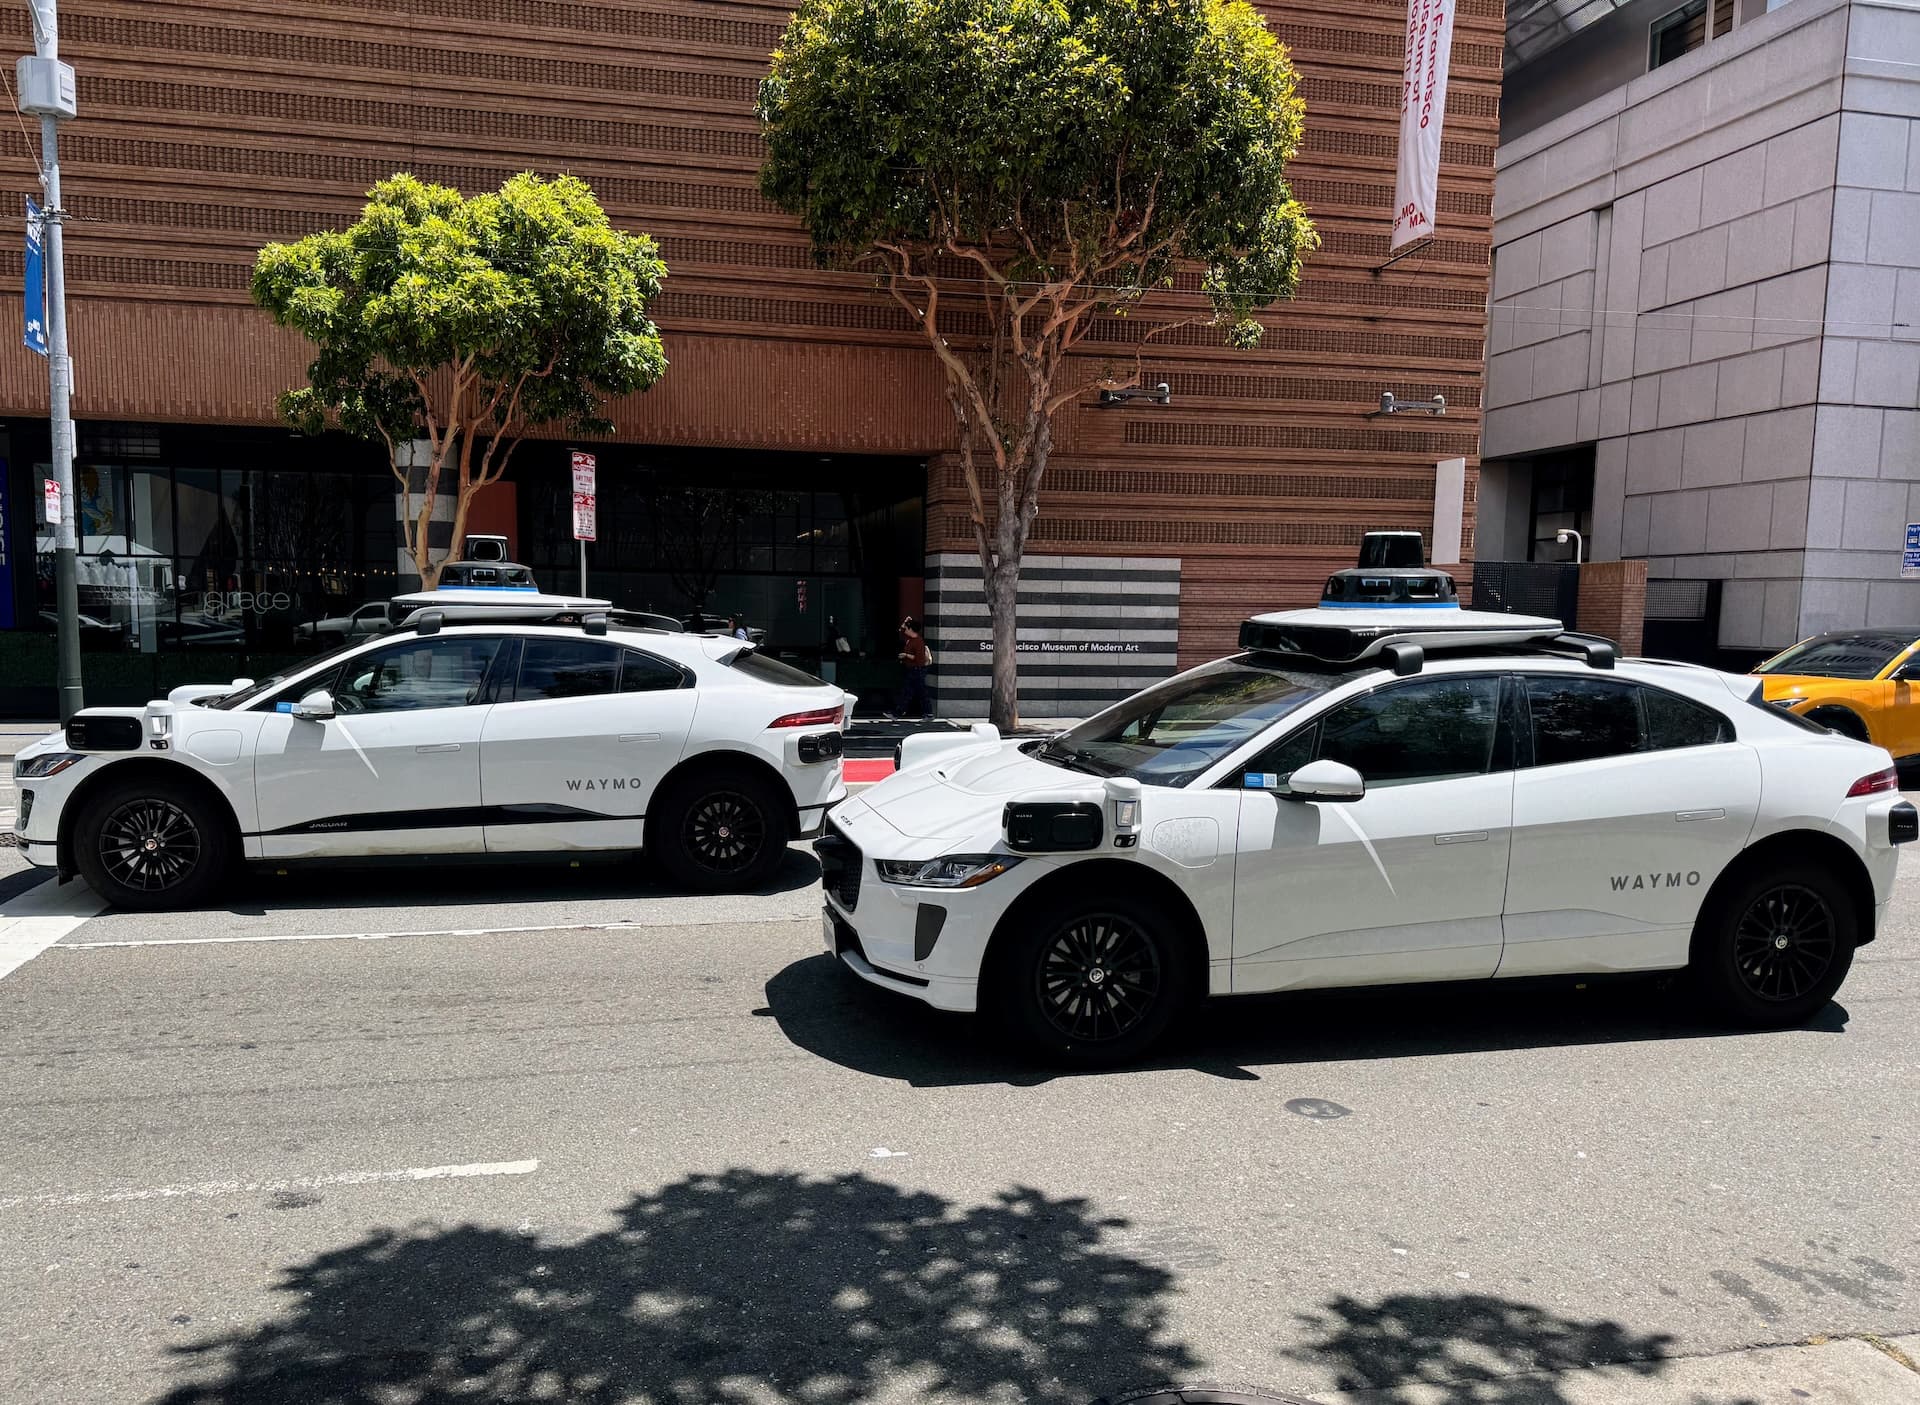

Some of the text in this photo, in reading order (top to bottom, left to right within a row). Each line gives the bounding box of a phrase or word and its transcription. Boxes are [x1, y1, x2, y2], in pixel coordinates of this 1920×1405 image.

[1412, 0, 1431, 104] useum of
[1420, 12, 1444, 129] Francisco
[1402, 81, 1411, 114] Art
[203, 591, 290, 619] grace
[1016, 642, 1040, 651] cisco
[1041, 642, 1078, 652] Museum
[1079, 643, 1089, 652] of
[1090, 643, 1124, 652] Modern
[1124, 643, 1140, 652] Art
[566, 777, 642, 792] WAYMO
[1610, 870, 1702, 892] WAYMO
